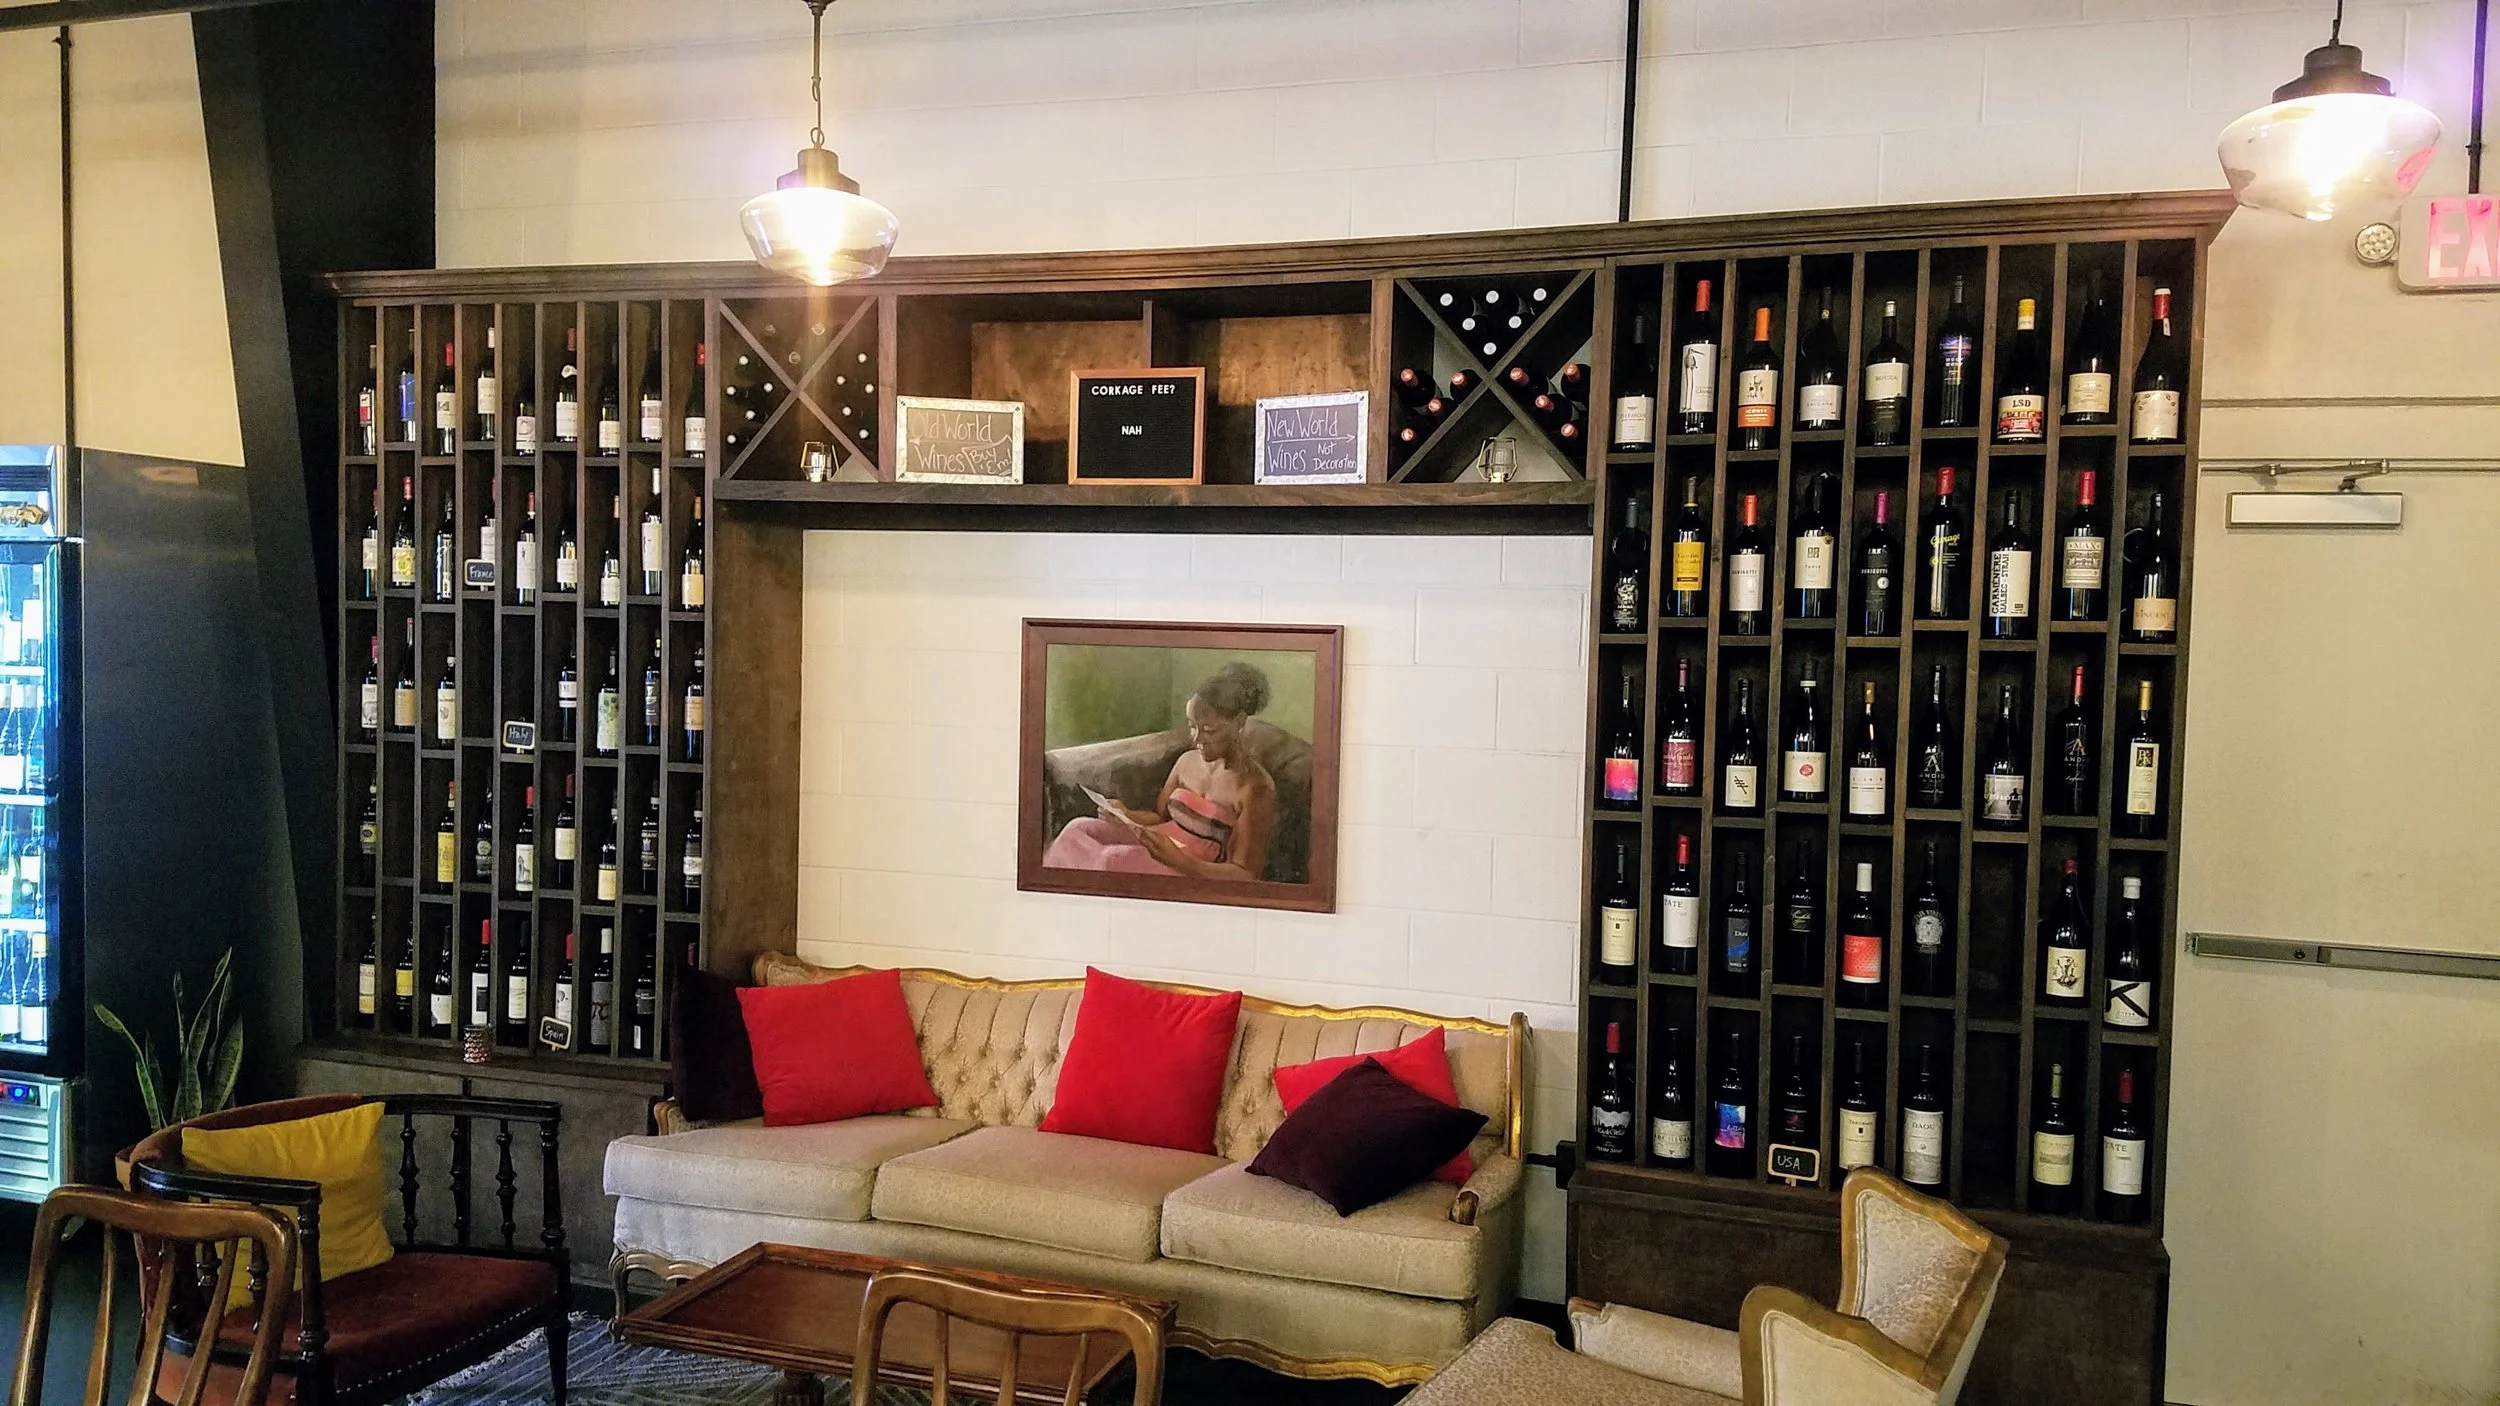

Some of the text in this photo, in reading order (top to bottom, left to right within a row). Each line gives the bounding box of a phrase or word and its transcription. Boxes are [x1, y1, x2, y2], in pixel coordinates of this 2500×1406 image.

[1091, 384, 1176, 396] CORKAGE FEE?
[2012, 399, 2031, 408] LSD
[911, 411, 994, 443] Old World
[1121, 425, 1143, 436] NAH
[1266, 408, 1338, 442] New World
[968, 447, 997, 464] Buy
[1317, 441, 1338, 456] Not
[913, 444, 965, 473] Wines
[1267, 443, 1307, 473] Wines
[1312, 453, 1357, 472] Decoration
[469, 565, 494, 581] France
[2000, 583, 2008, 614] MALBEC
[2105, 979, 2149, 1019] K
[544, 1024, 564, 1042] Spain
[1777, 1154, 1800, 1171] USA
